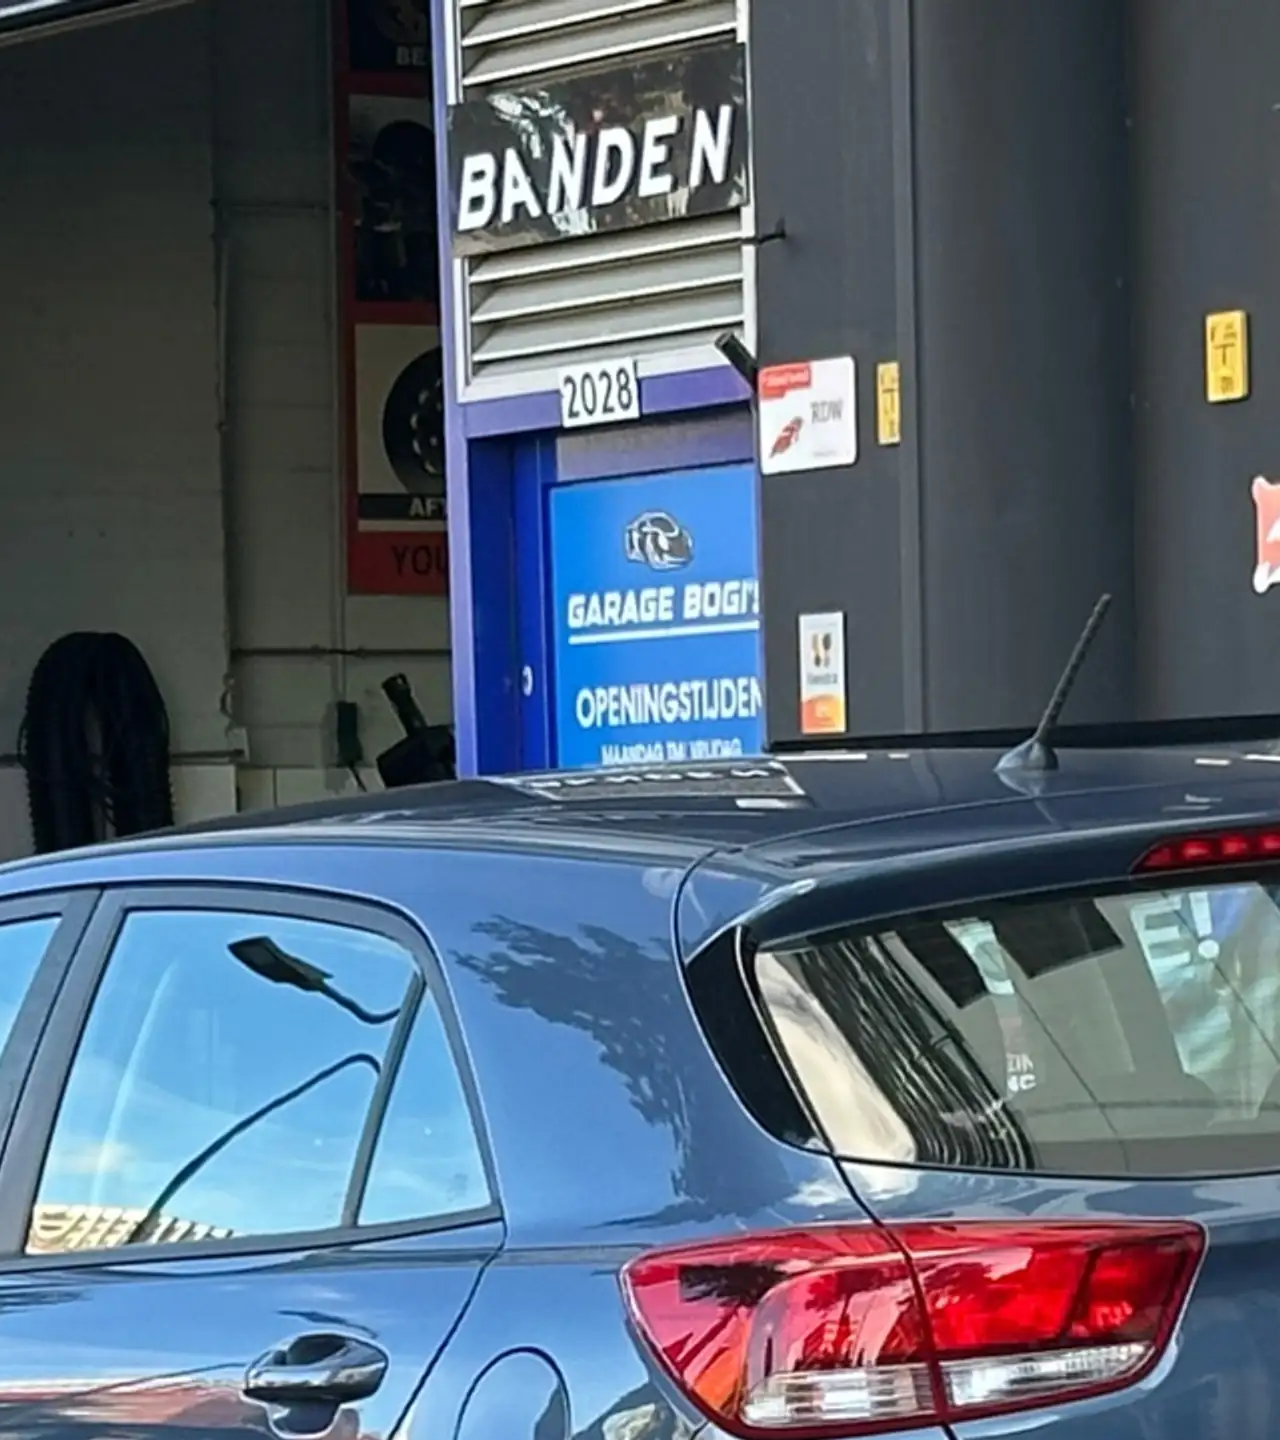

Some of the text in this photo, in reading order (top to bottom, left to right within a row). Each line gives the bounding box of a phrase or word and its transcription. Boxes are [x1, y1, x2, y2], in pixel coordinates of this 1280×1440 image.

[457, 104, 733, 231] BANDEN
[563, 366, 633, 418] 2028
[567, 586, 675, 628] GARAGE
[576, 676, 763, 728] OPENINGSTIJDEN
